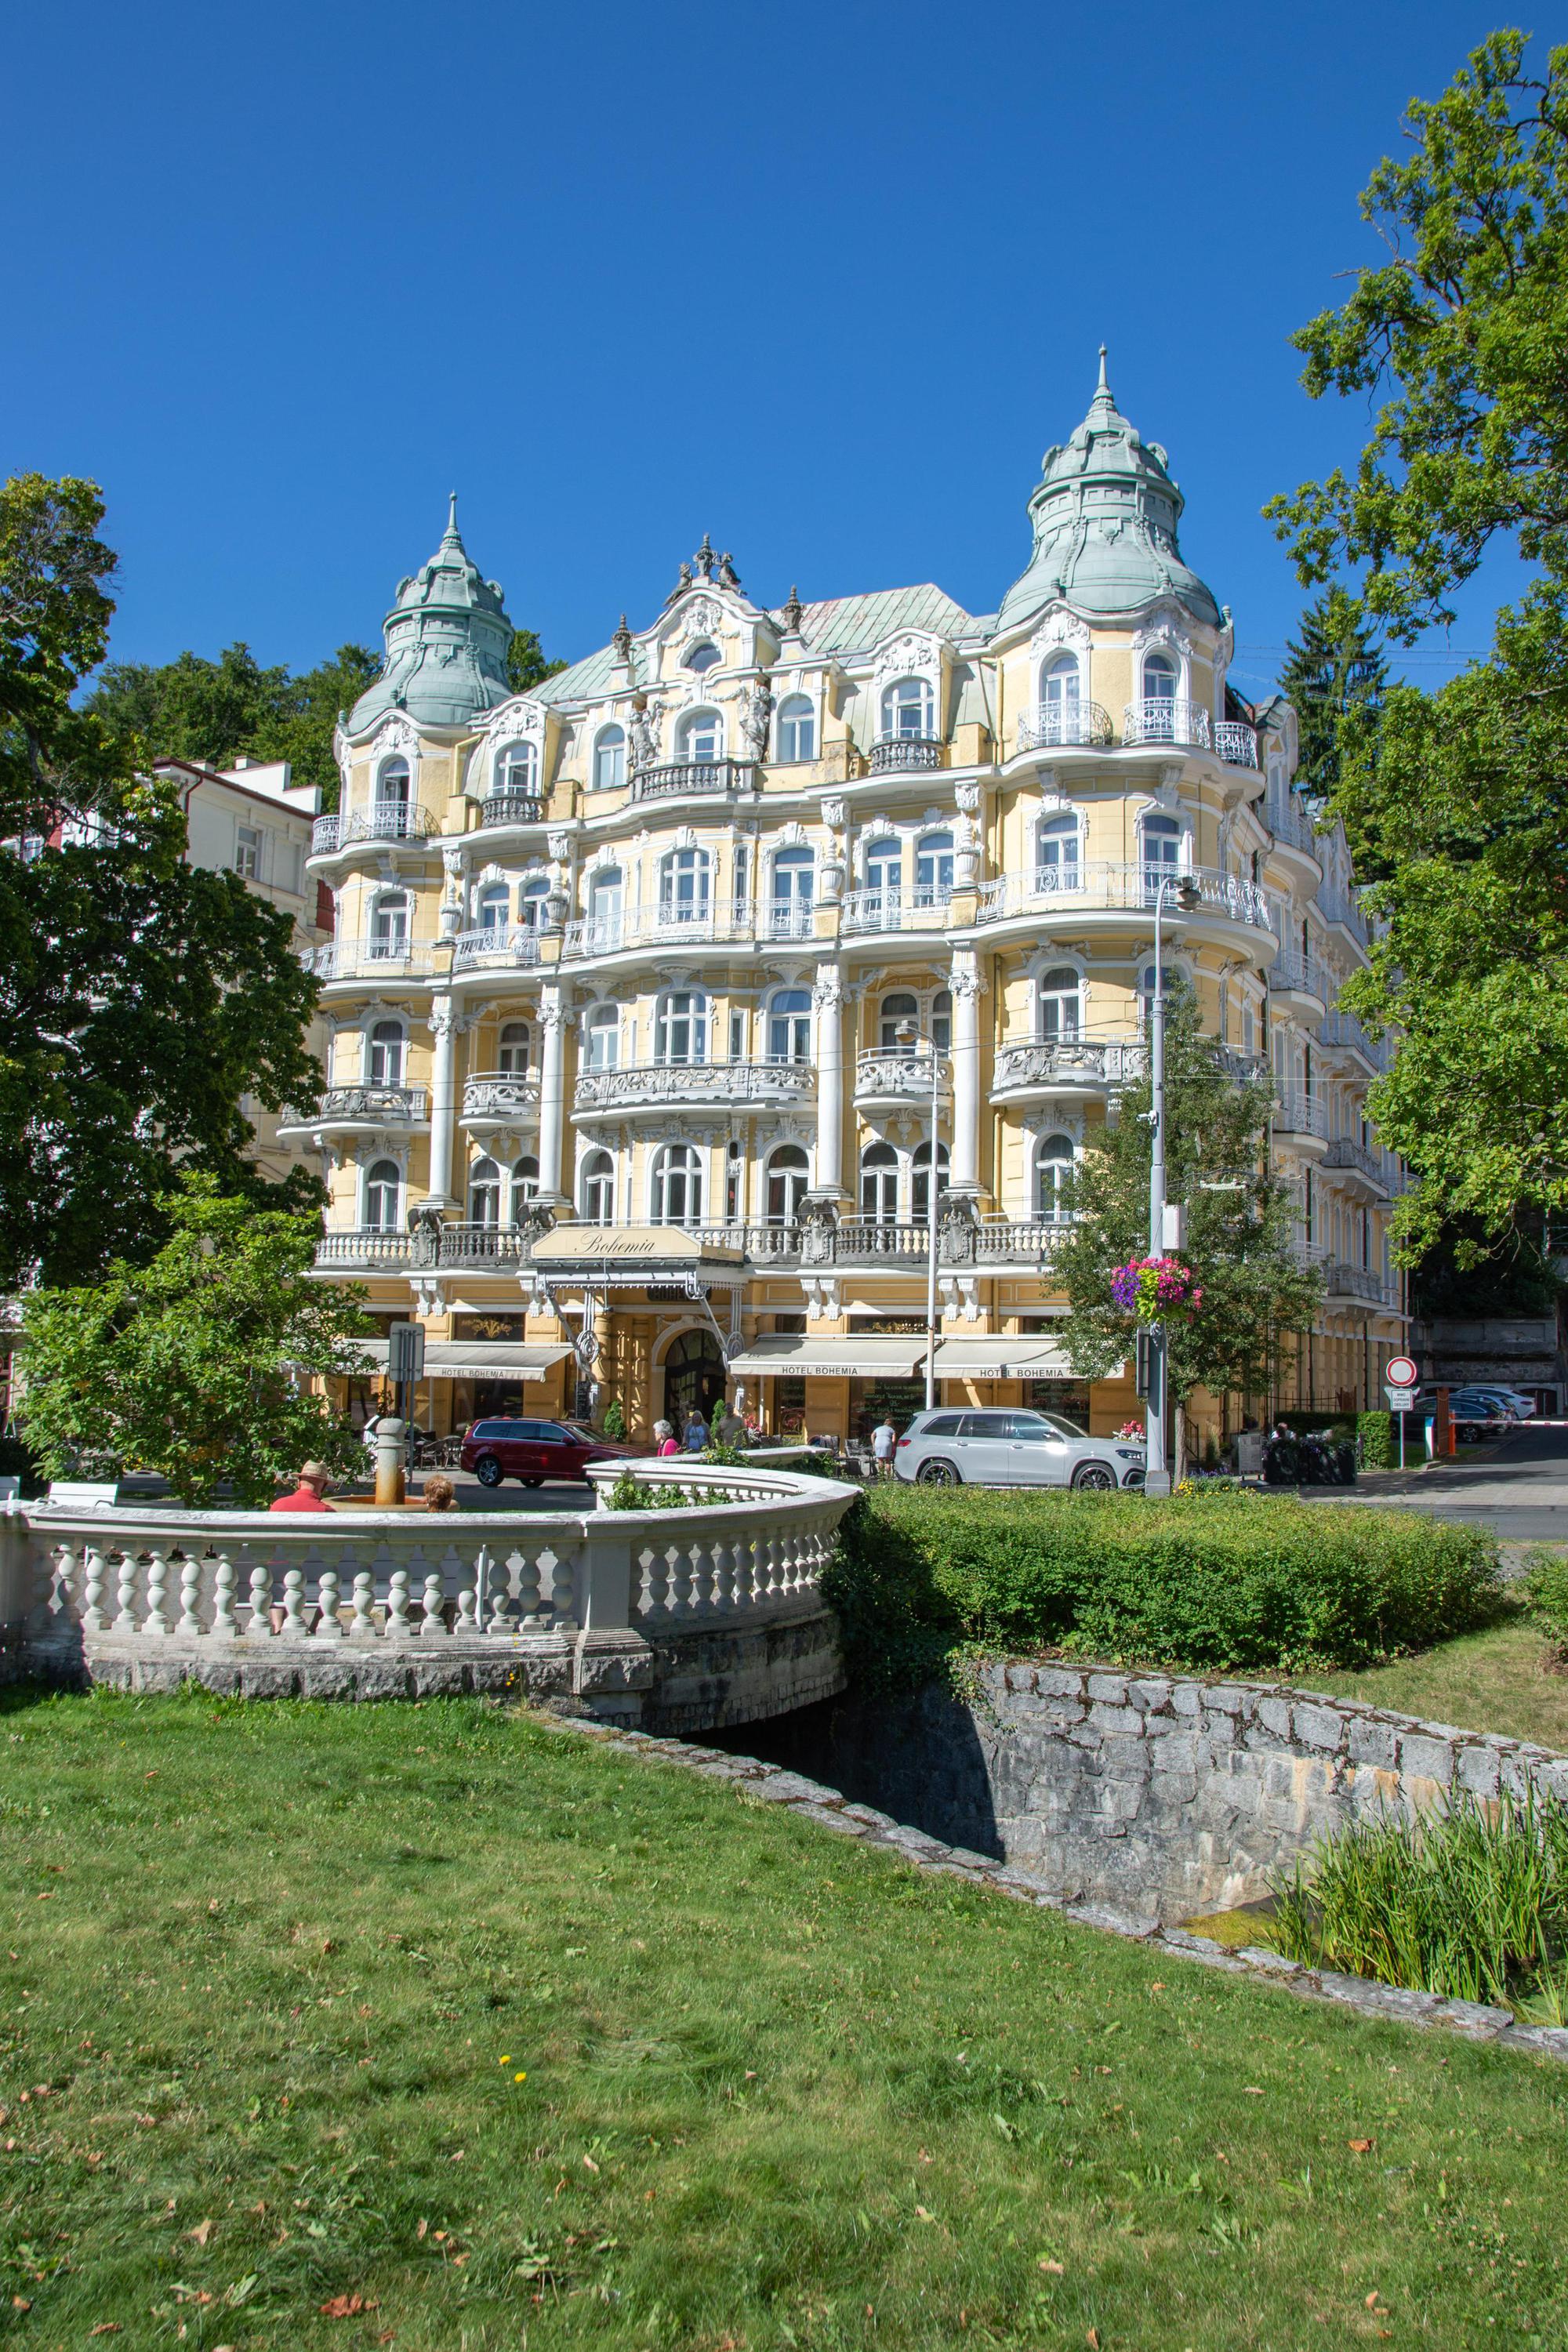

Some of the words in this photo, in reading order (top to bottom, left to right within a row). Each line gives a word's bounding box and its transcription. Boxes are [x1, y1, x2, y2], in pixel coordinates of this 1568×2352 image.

[574, 1231, 655, 1254] Bohemia
[469, 1370, 504, 1378] BOHEMIA
[815, 1367, 858, 1375] BOHEMIA
[980, 1369, 1013, 1377] HOTEL
[1017, 1369, 1064, 1377] BOHEMIA
